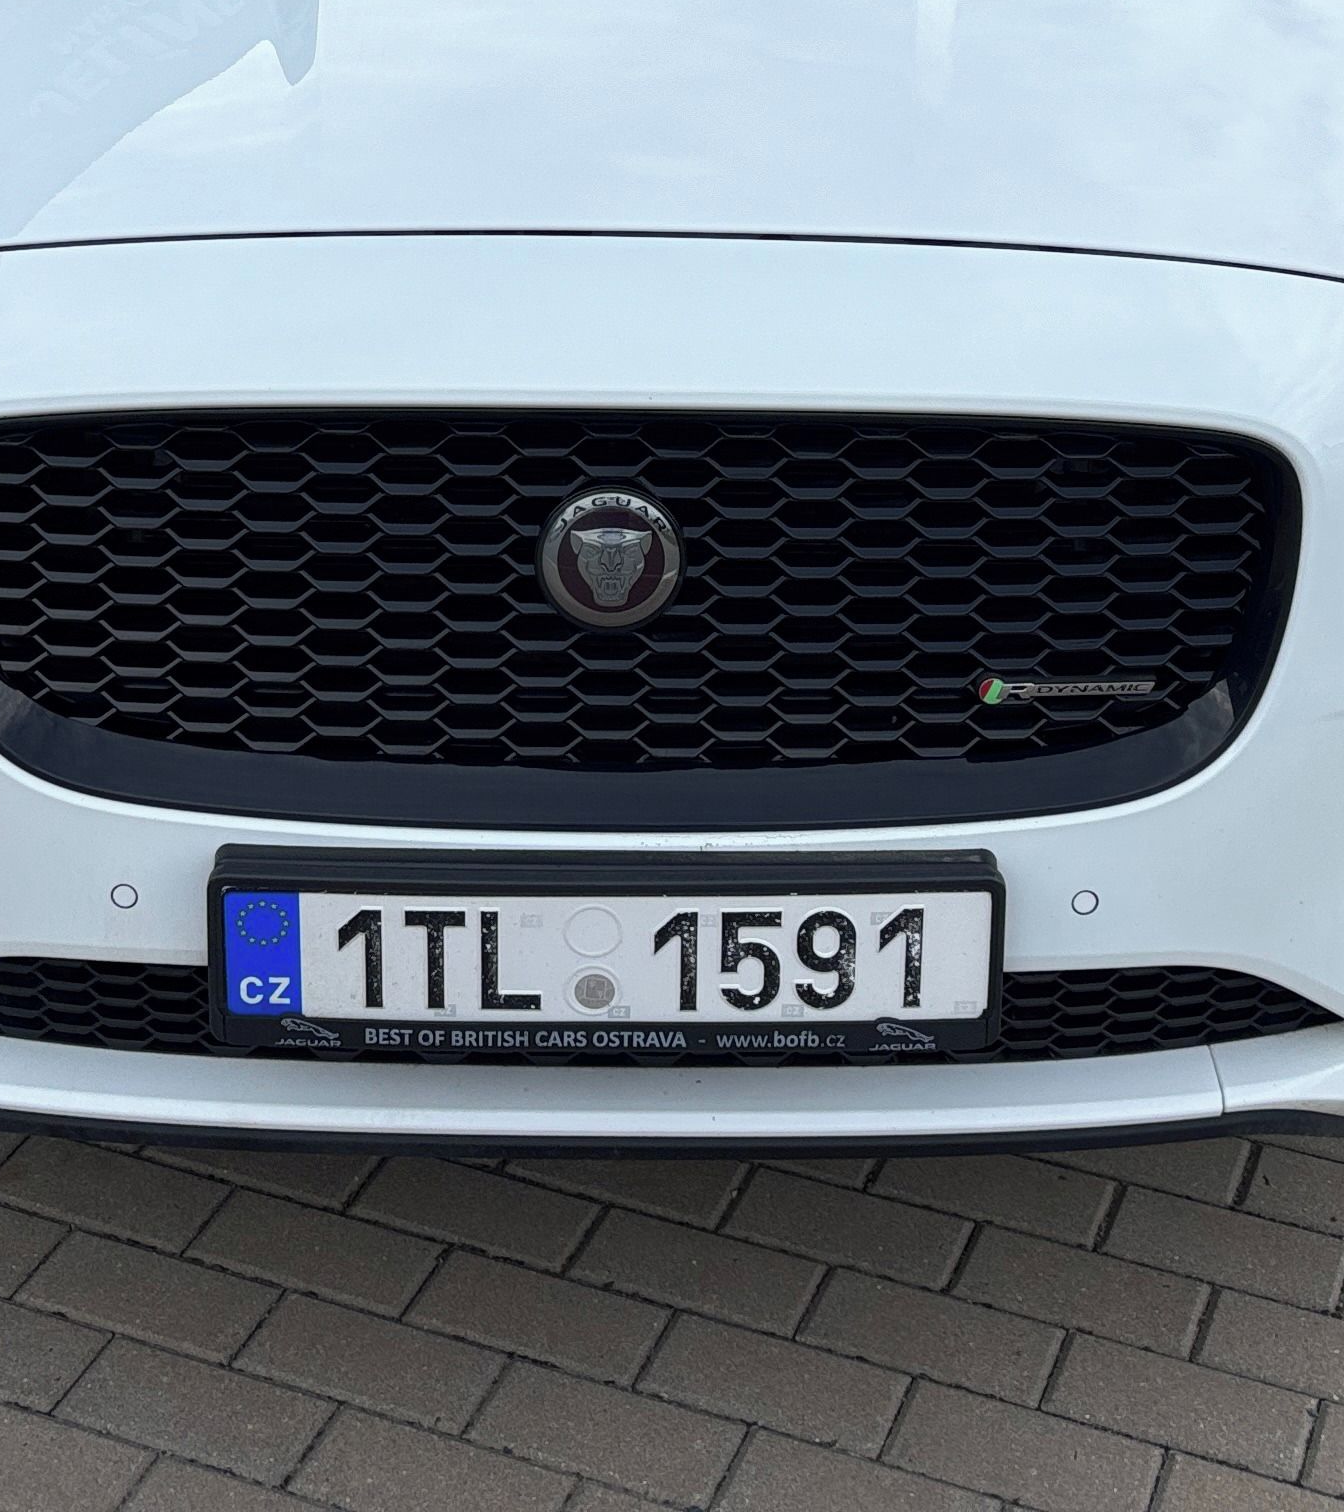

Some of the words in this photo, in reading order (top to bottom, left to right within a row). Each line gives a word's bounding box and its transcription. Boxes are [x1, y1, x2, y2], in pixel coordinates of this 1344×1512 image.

[554, 495, 668, 535] JAGUAR
[337, 908, 543, 1011] 1TL
[653, 907, 924, 1013] 1591
[239, 976, 292, 1005] CZ
[274, 1038, 342, 1048] JAGUAR
[365, 1028, 414, 1045] BEST
[418, 1028, 445, 1046] OF
[451, 1029, 529, 1047] BRITISH
[535, 1030, 588, 1048] CARS
[592, 1031, 687, 1049] OSTRAVA
[716, 1030, 846, 1049] www.bofb.cz
[869, 1042, 936, 1051] JAGUAR
